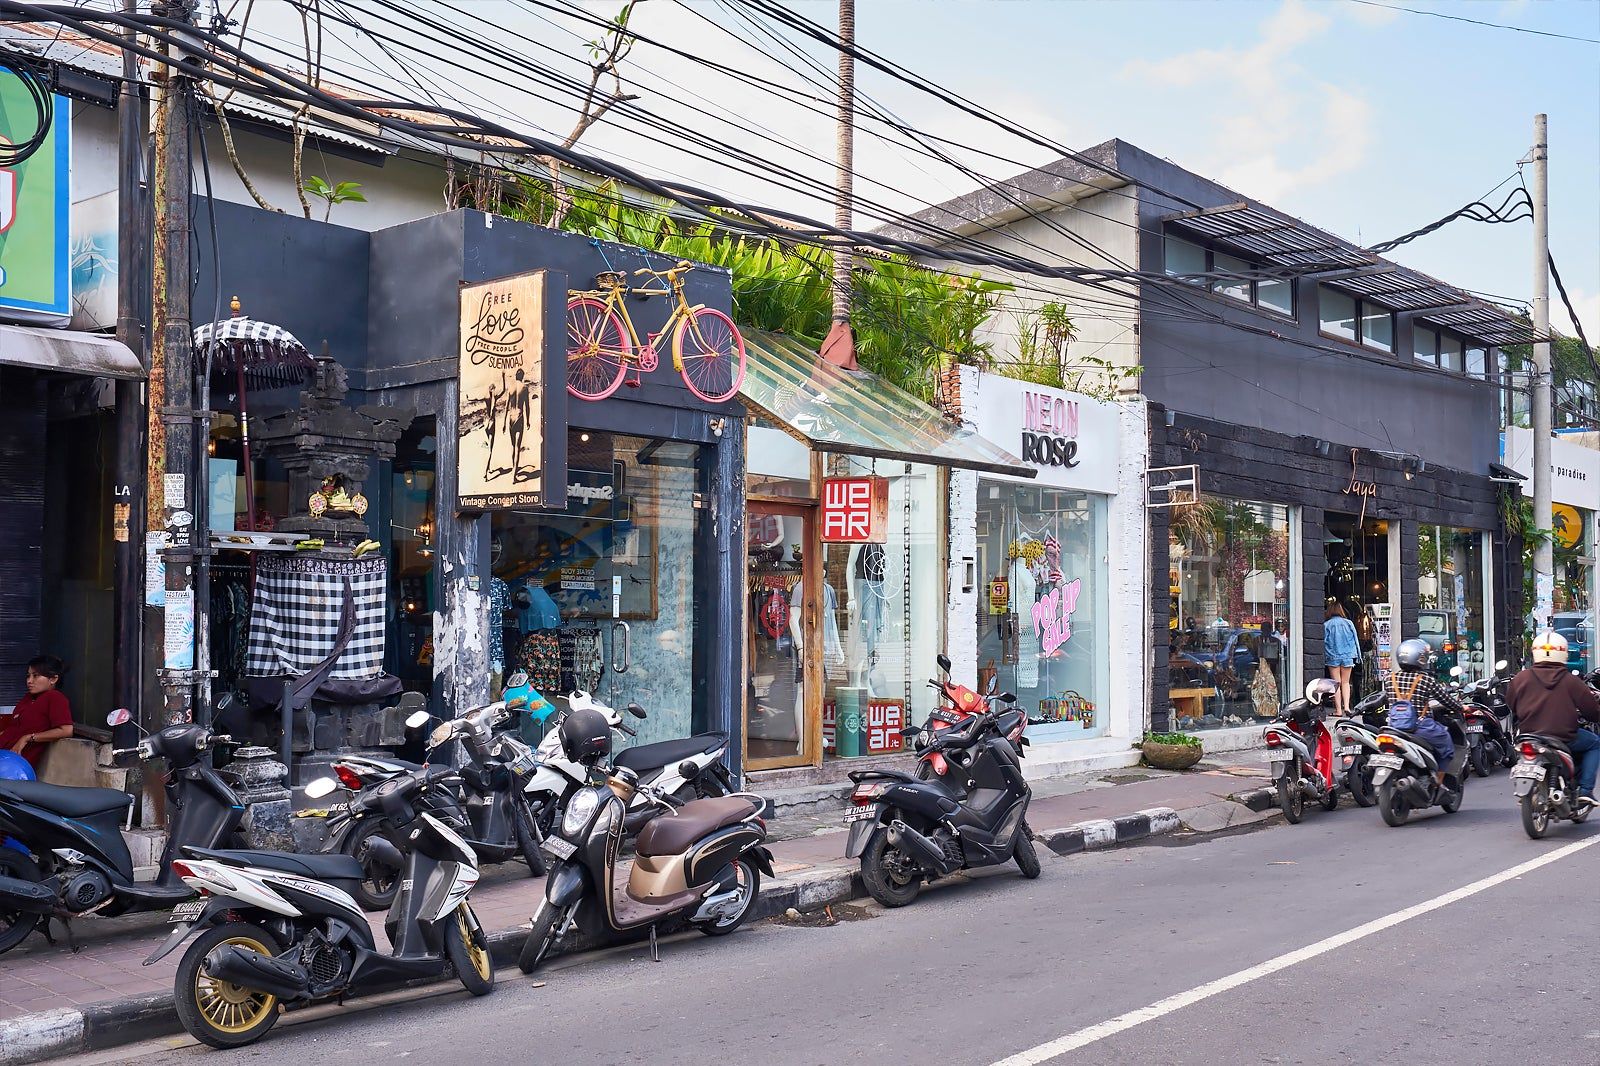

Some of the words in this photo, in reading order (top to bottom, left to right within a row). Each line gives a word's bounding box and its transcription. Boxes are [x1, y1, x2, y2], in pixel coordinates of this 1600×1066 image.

[487, 293, 512, 306] FREE
[478, 341, 490, 350] FREE
[1022, 391, 1078, 439] NEON
[1557, 467, 1586, 481] paradise
[115, 486, 130, 496] LA
[1342, 447, 1376, 529] Jaya
[460, 497, 486, 508] Vintage
[487, 495, 517, 507] Concept
[518, 494, 539, 503] Store
[825, 512, 869, 536] AR
[1031, 588, 1059, 641] POP
[1062, 578, 1080, 615] UP
[1042, 614, 1071, 658] SALE
